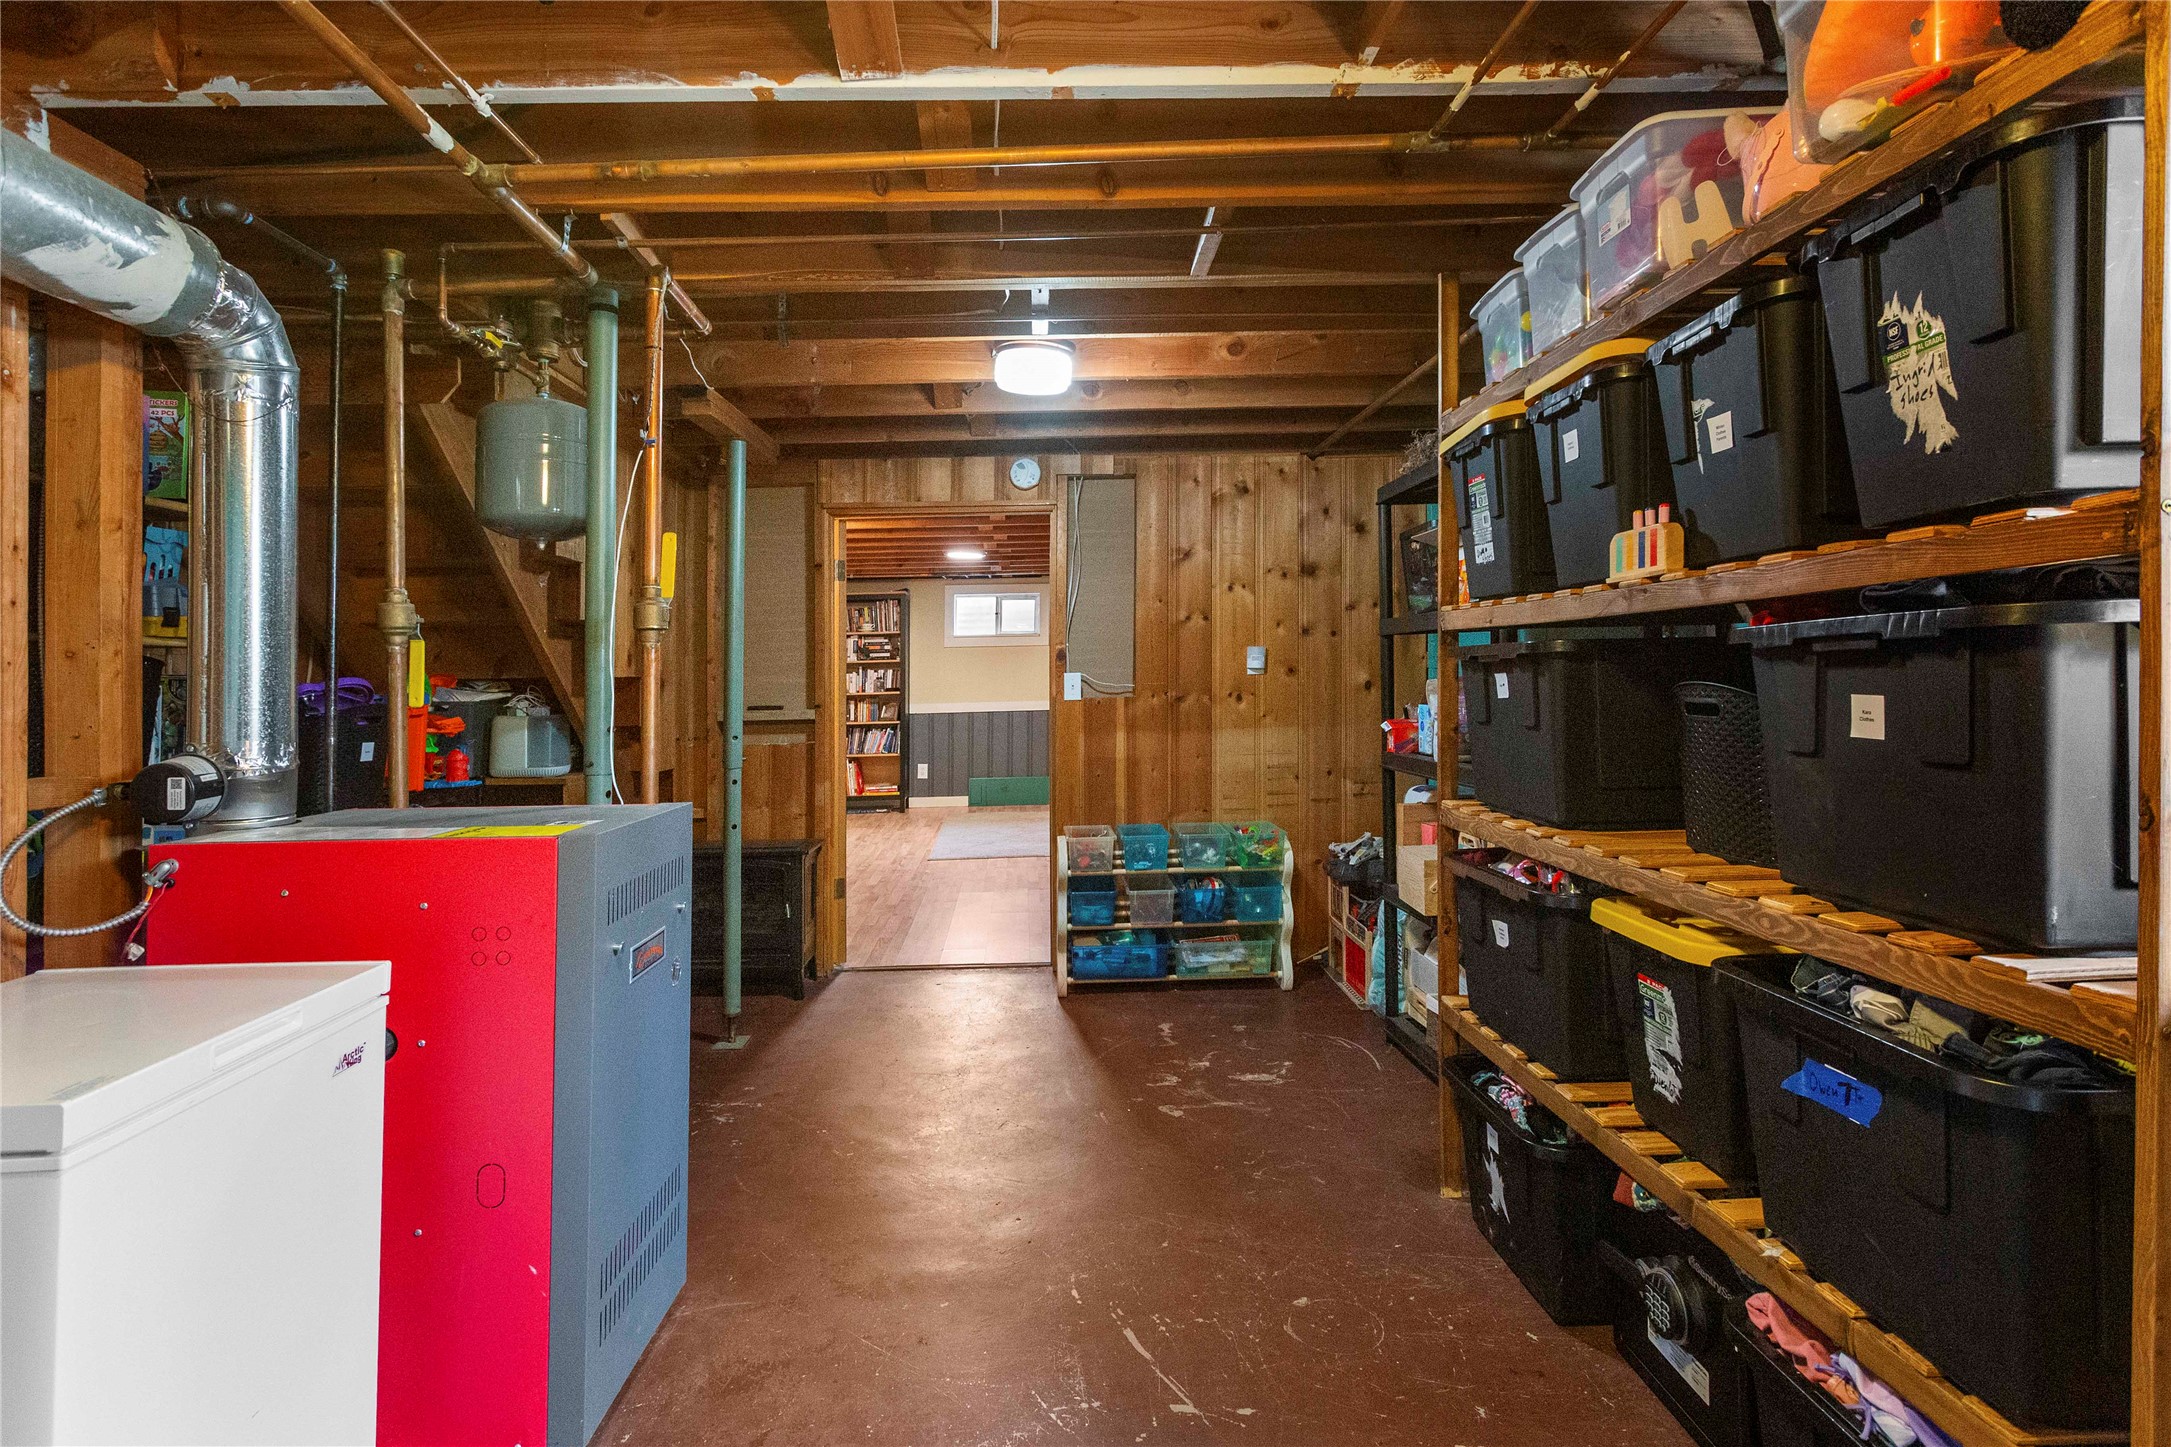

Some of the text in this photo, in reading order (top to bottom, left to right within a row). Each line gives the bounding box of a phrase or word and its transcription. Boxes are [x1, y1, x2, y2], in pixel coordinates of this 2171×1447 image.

[1918, 320, 1929, 333] 12
[1925, 334, 1944, 348] GRADE
[148, 399, 178, 407] TICKERS
[342, 1046, 364, 1062] Arctic
